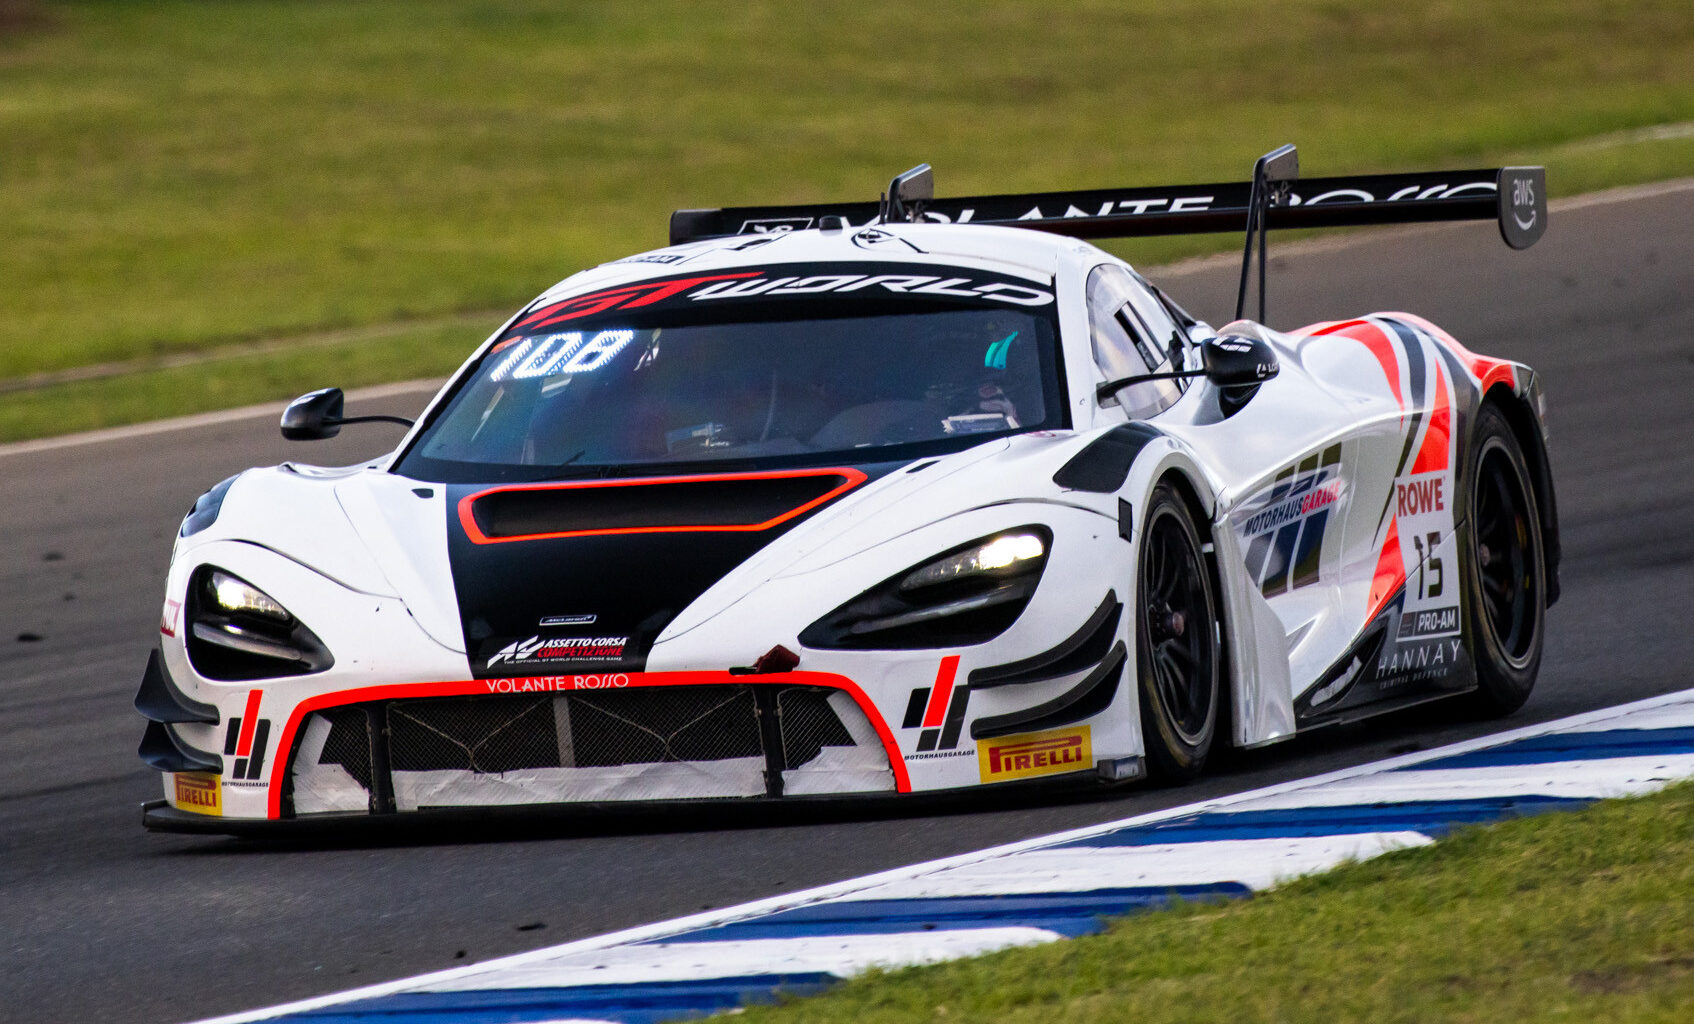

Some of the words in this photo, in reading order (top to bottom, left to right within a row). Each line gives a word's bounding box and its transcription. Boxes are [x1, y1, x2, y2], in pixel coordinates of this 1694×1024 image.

[1513, 178, 1535, 207] aws
[689, 275, 1055, 306] WORLD
[1398, 479, 1444, 517] ROWE
[1413, 531, 1444, 601] 15
[1417, 608, 1457, 632] PRO-AM
[537, 645, 624, 658] COMPETIZIONE
[545, 638, 591, 648] ASSETTO
[592, 637, 628, 647] CORSA
[1375, 639, 1462, 680] HANNAY
[486, 676, 565, 694] VOLANTE
[574, 673, 629, 690] ROSSO
[904, 750, 975, 761] MOTORHAUSGARAGE
[989, 735, 1082, 774] PIRELLI
[176, 776, 216, 807] PIRELLI
